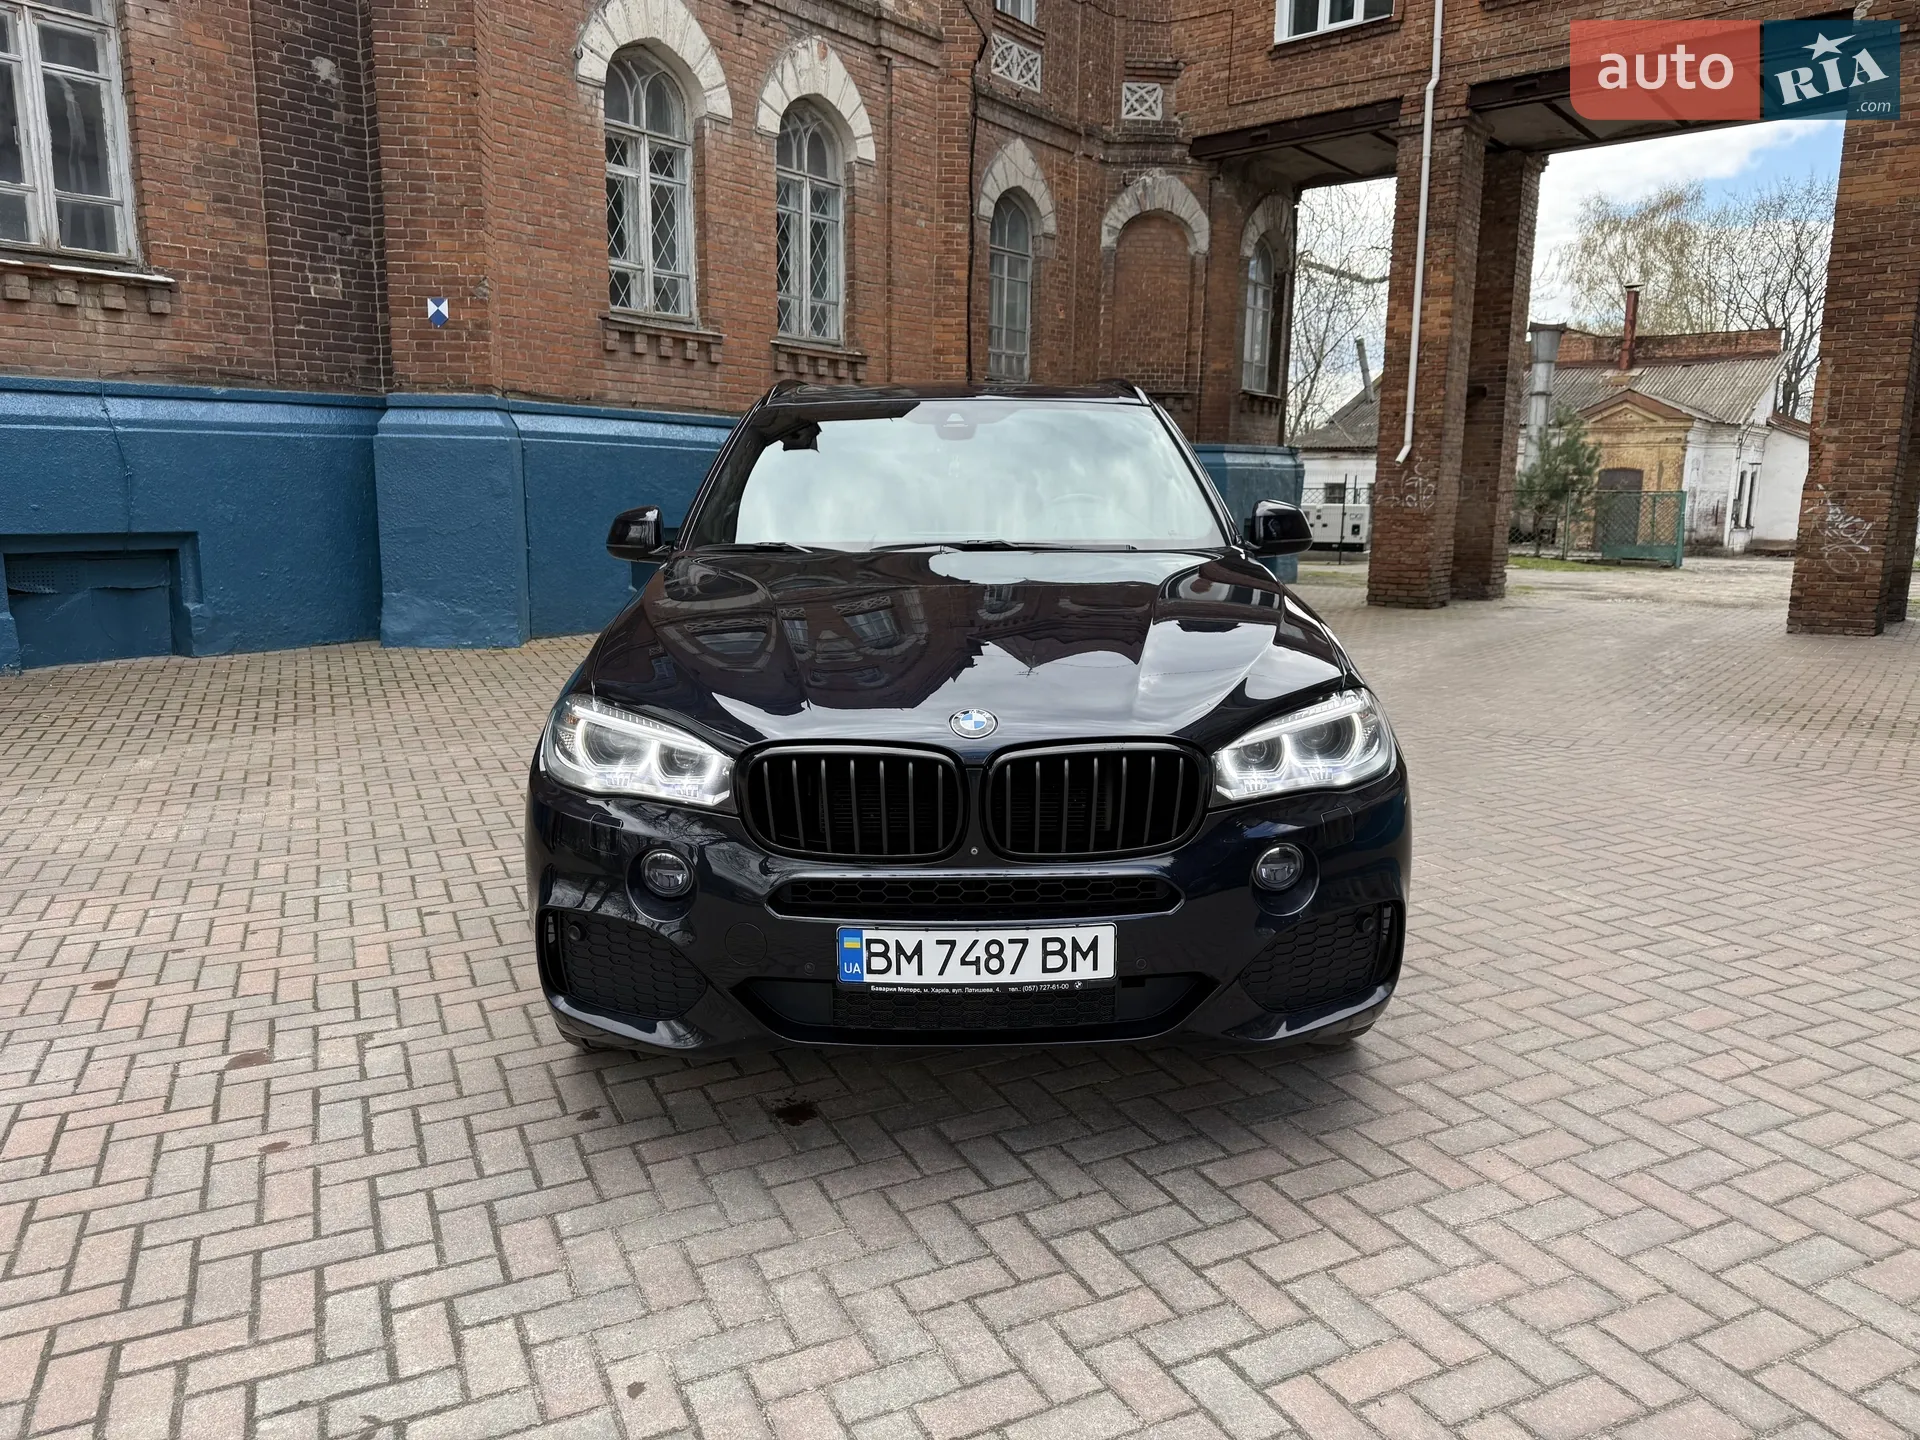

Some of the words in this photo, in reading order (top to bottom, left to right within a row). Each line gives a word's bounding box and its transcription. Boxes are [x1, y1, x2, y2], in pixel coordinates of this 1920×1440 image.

[865, 938, 923, 976] BM
[935, 938, 1030, 976] 7487
[1041, 935, 1099, 974] BM
[843, 962, 862, 974] UA
[1022, 985, 1038, 993] (057)
